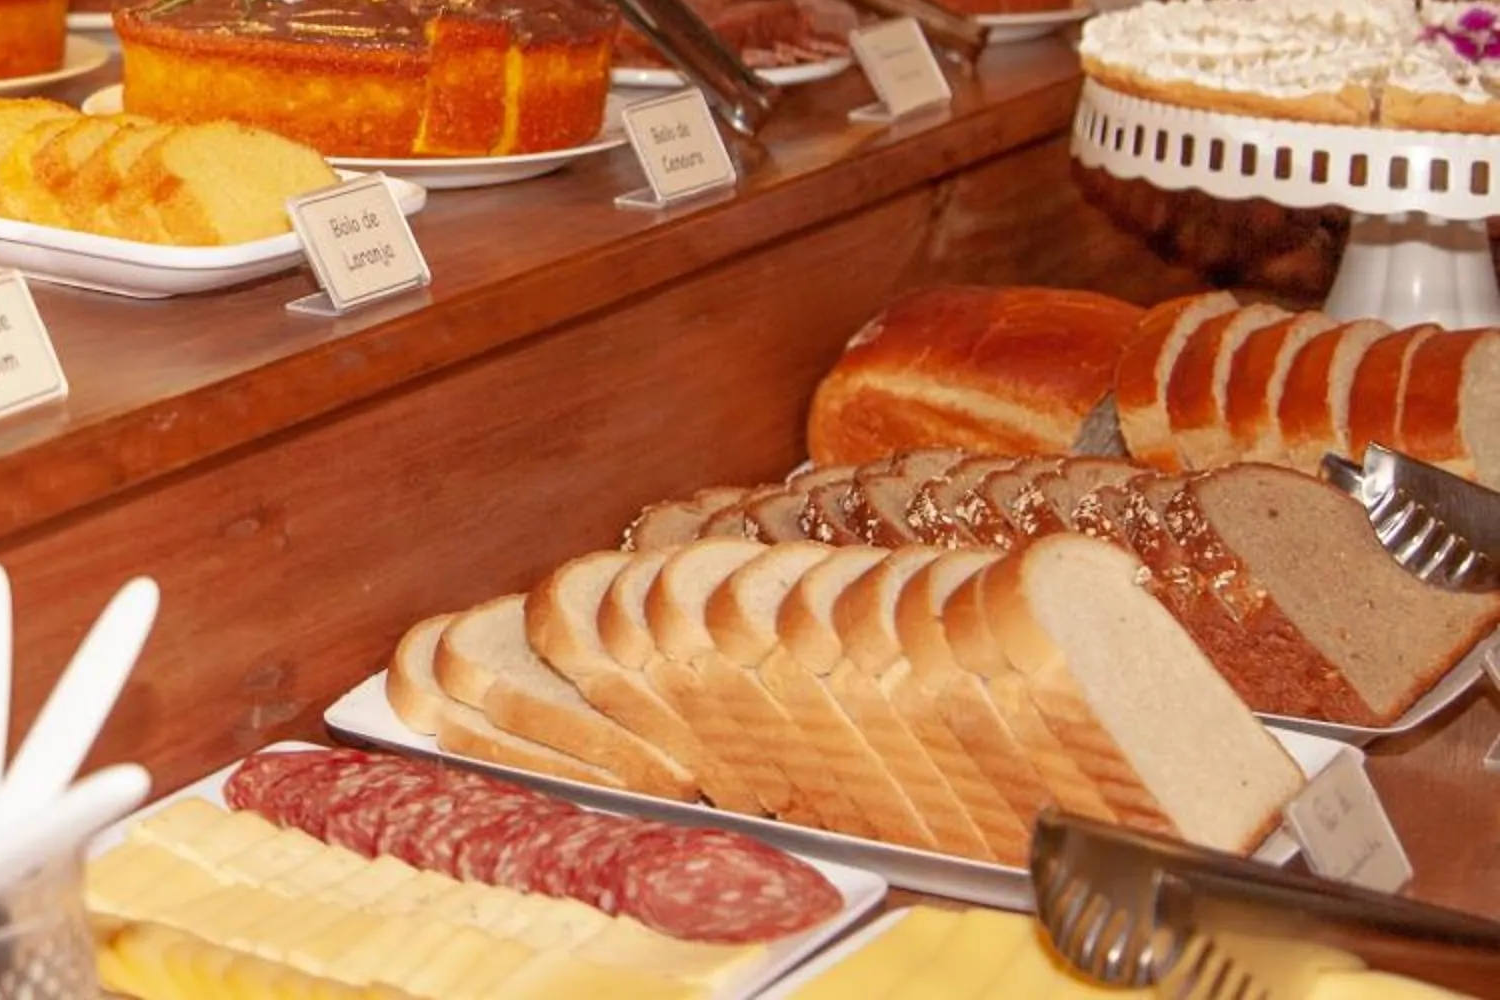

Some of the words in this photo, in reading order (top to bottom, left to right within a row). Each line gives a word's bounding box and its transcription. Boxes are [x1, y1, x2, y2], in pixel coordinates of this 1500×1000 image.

[329, 215, 361, 238] Bolo
[361, 208, 380, 229] de
[343, 243, 396, 271] Laranja
